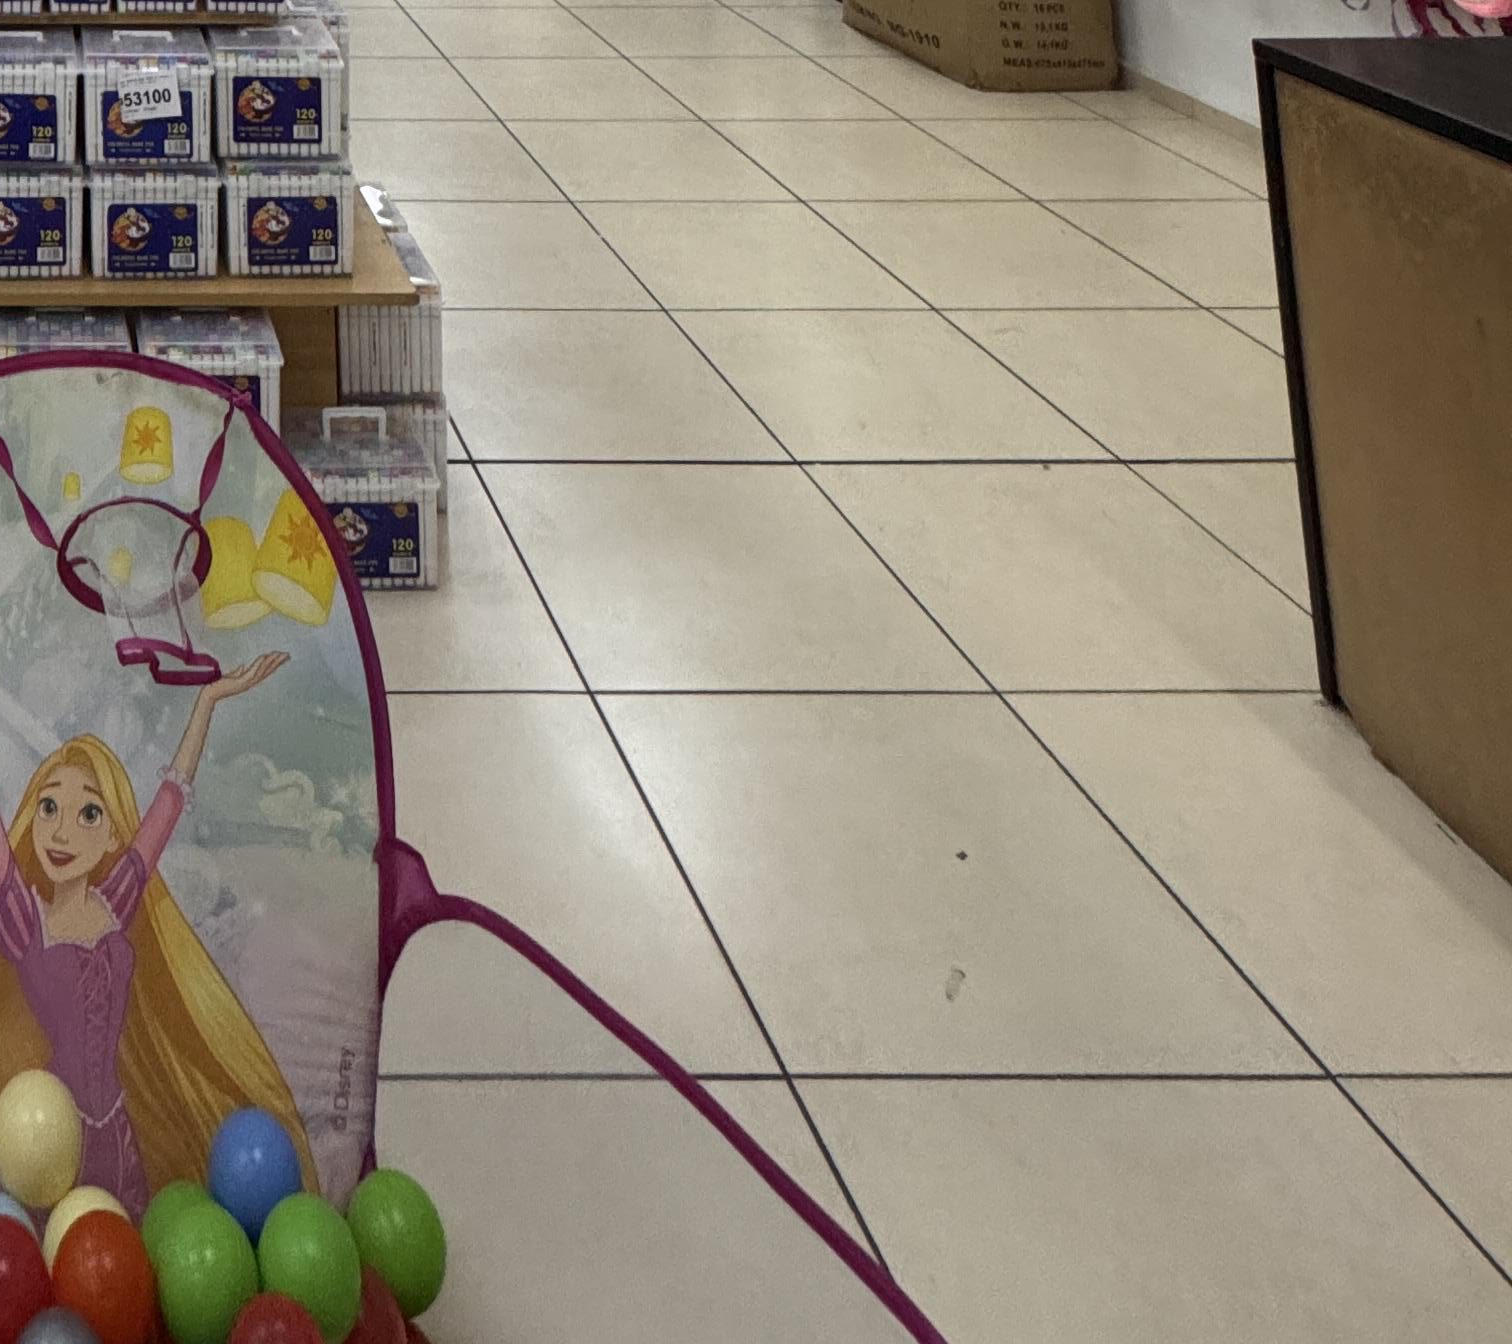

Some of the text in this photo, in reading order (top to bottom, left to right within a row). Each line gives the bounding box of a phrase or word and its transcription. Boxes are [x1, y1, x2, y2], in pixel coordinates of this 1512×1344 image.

[295, 107, 316, 120] 120
[32, 125, 53, 138] 120
[167, 122, 187, 136] 120
[39, 229, 61, 242] 120
[312, 228, 333, 242] 120
[171, 235, 193, 249] 120
[391, 538, 414, 551] 120
